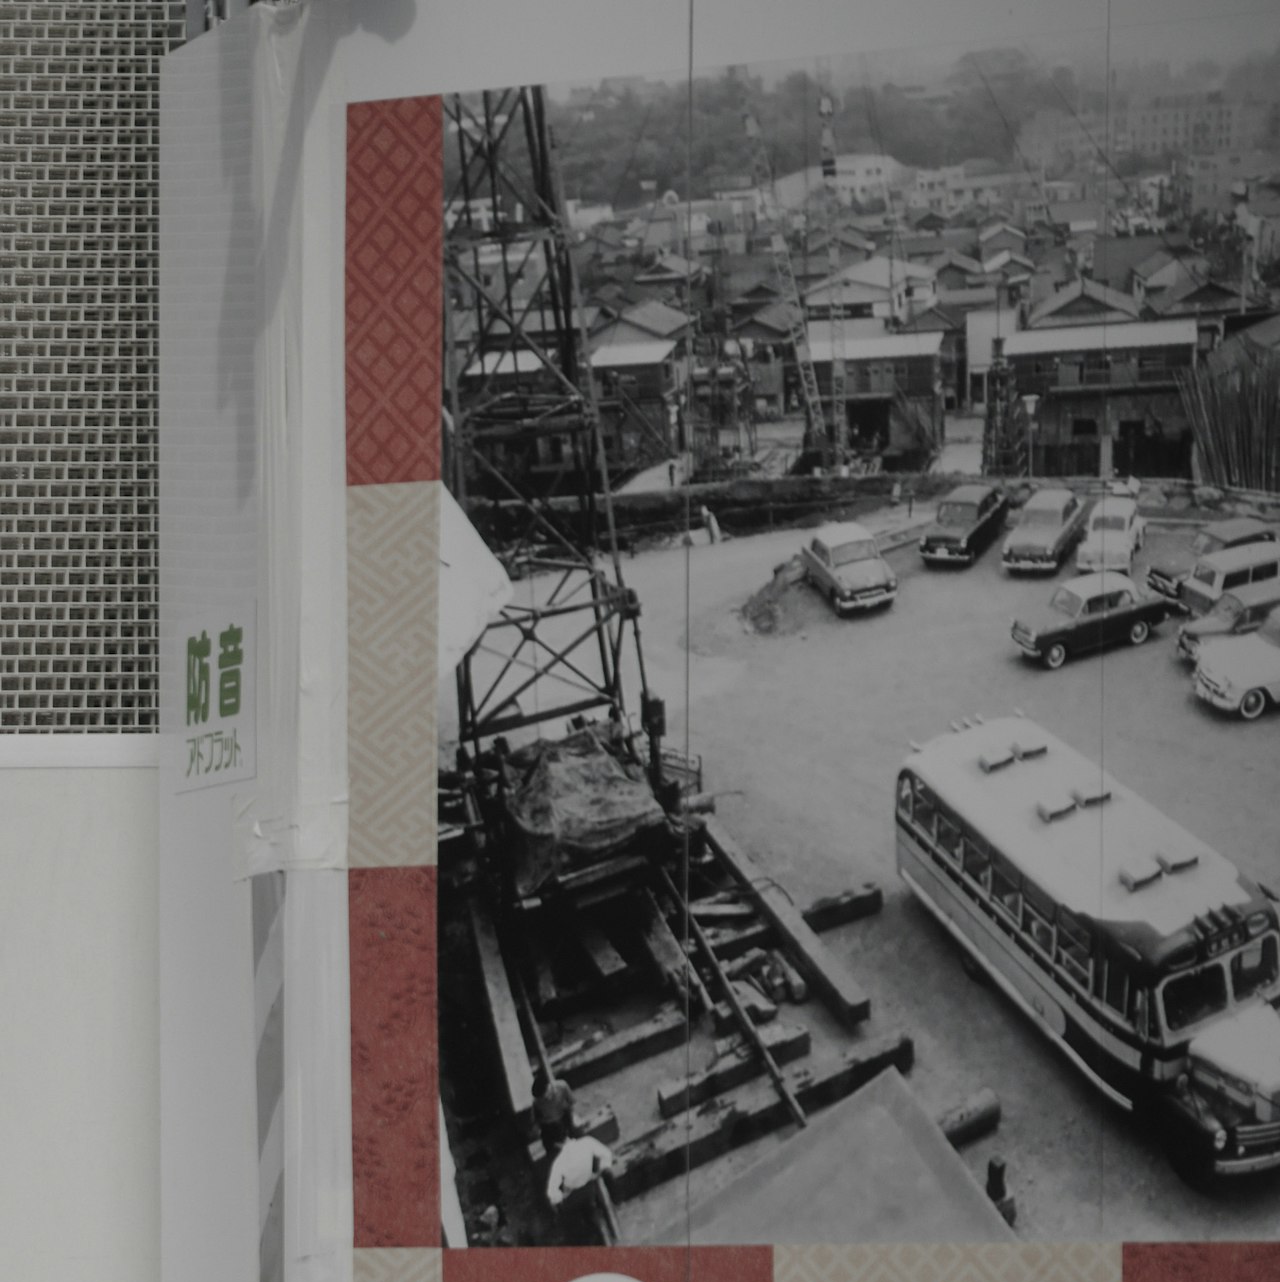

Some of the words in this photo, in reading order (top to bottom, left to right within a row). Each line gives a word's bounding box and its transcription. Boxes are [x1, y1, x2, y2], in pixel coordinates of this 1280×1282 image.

[187, 622, 243, 727] 防音
[186, 727, 242, 778] アドフラット
